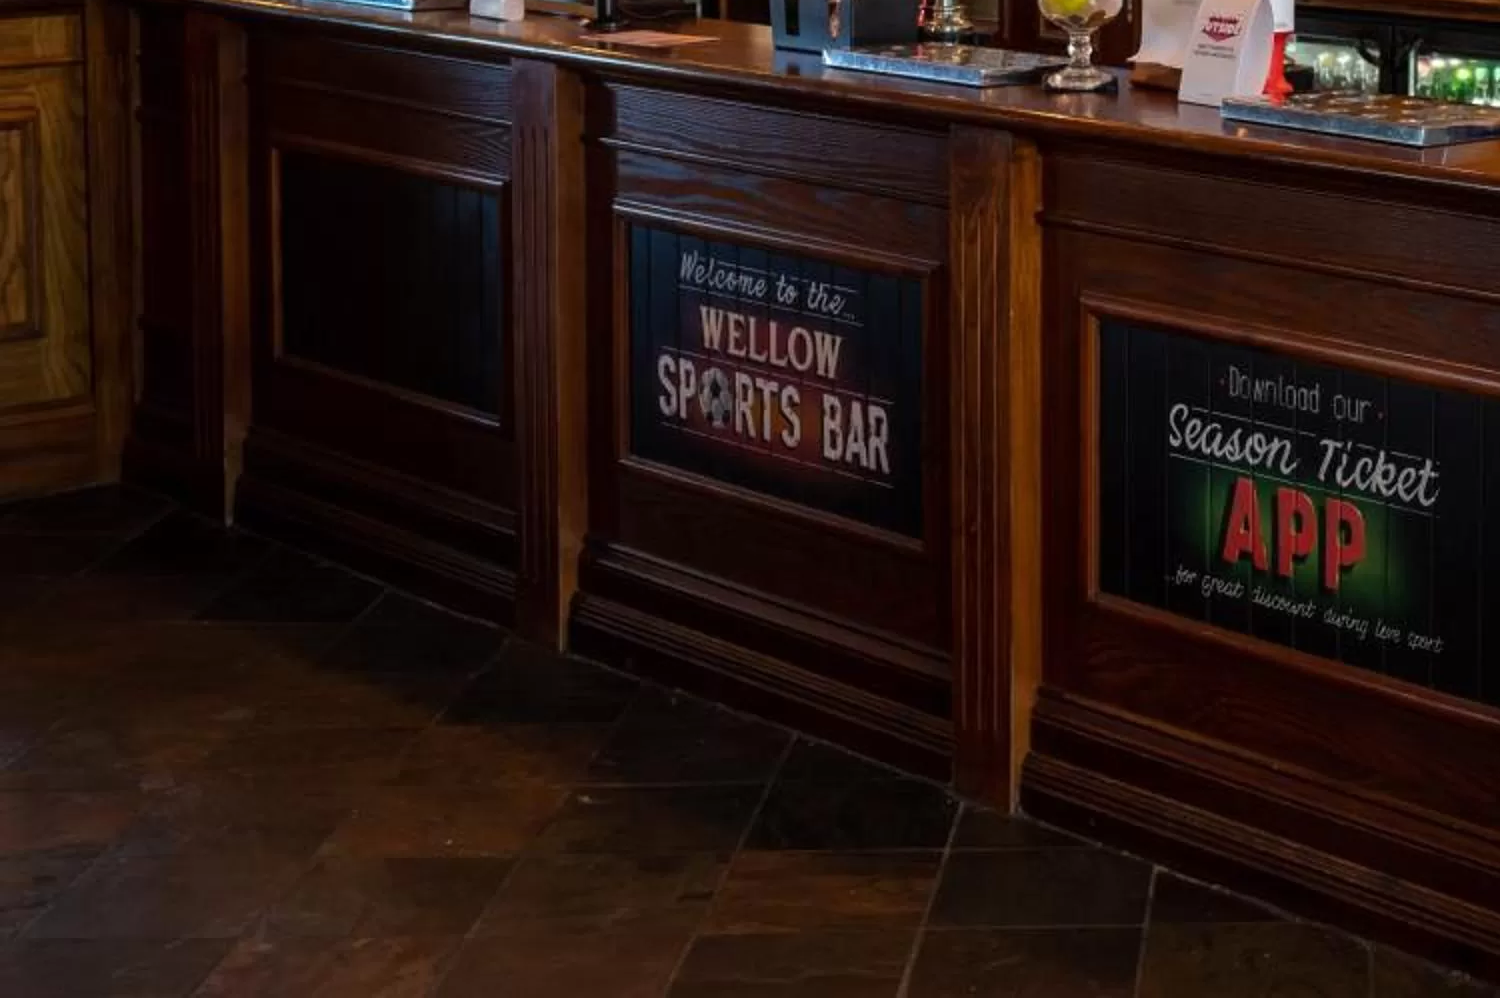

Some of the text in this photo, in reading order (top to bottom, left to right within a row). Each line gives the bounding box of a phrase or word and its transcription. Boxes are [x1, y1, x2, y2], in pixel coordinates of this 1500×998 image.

[679, 249, 768, 298] Welcome
[775, 272, 800, 304] to
[700, 305, 845, 380] WELLOW
[657, 353, 892, 475] SPORTS BAR
[1228, 364, 1373, 423] Download our
[1168, 402, 1441, 507] Season Ticket
[1220, 476, 1367, 593] APP
[1200, 573, 1245, 598] great
[1251, 585, 1318, 619] discount
[1323, 608, 1370, 641] during
[1407, 630, 1445, 654] sport
